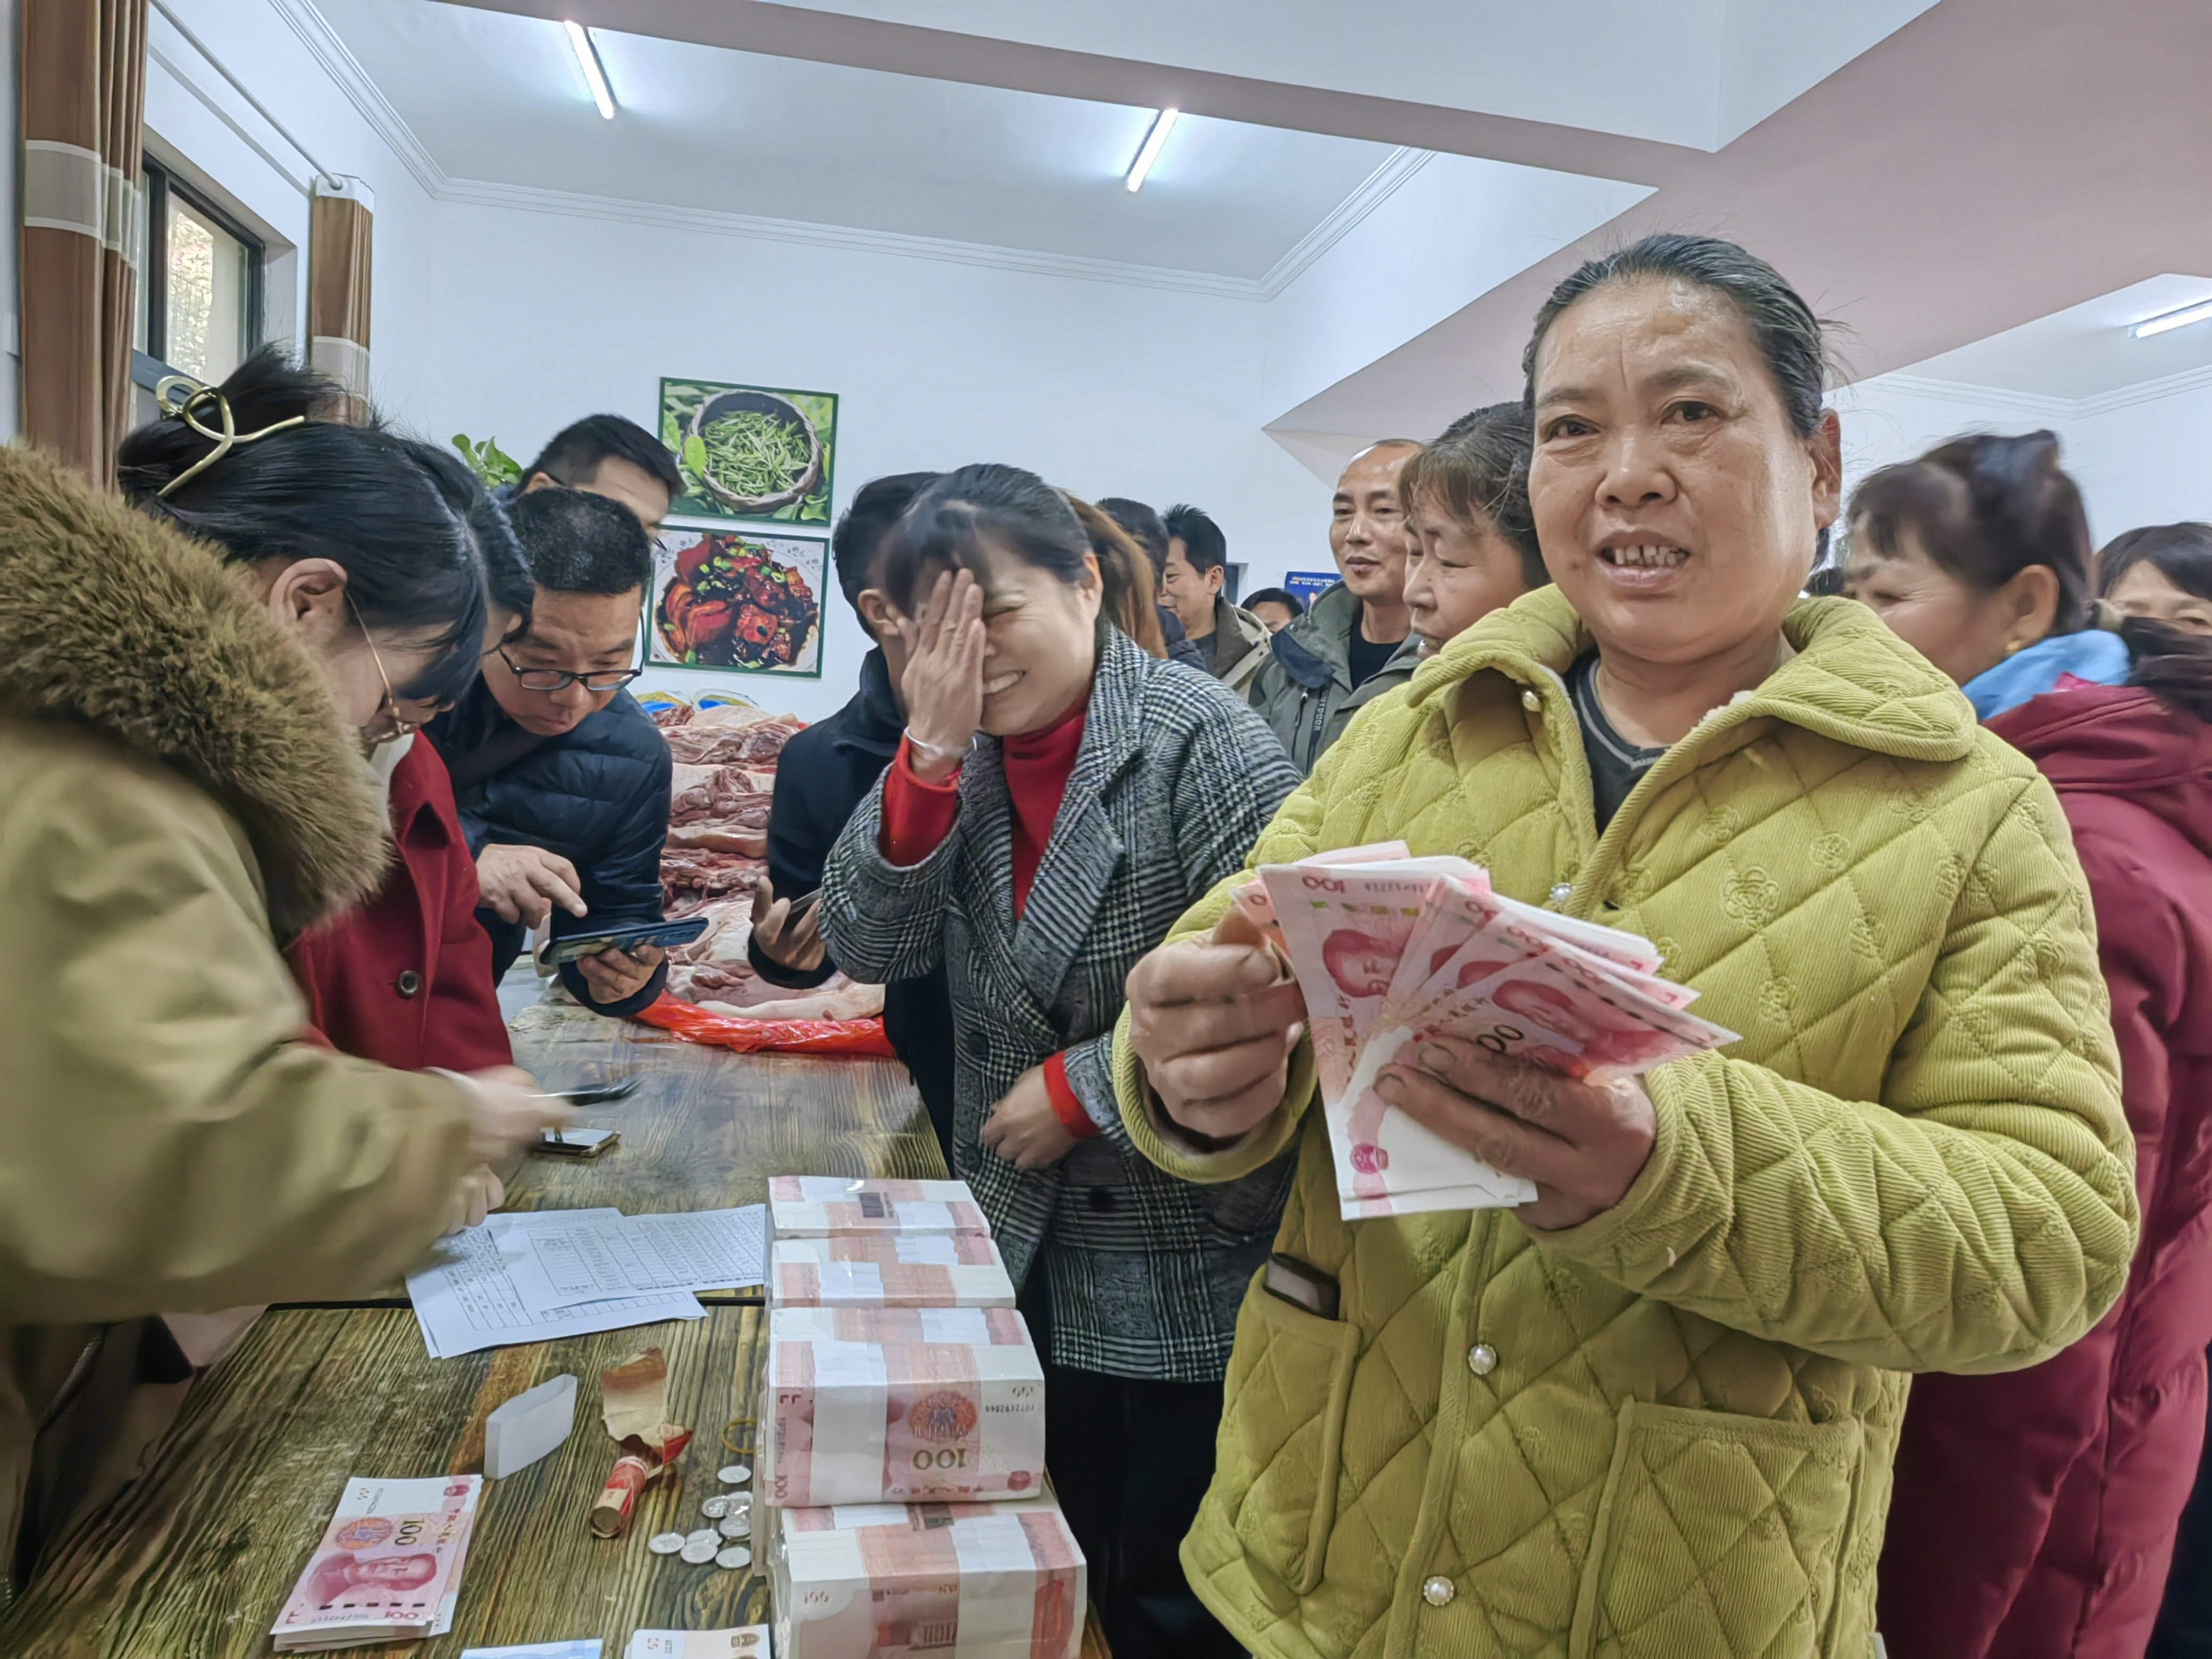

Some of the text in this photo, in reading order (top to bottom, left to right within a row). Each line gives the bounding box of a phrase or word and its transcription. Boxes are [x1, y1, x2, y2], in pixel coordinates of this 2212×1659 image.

[1476, 1024, 1525, 1054] 00
[912, 1448, 967, 1470] 100
[395, 1518, 425, 1545] 100
[384, 1611, 418, 1620] 100
